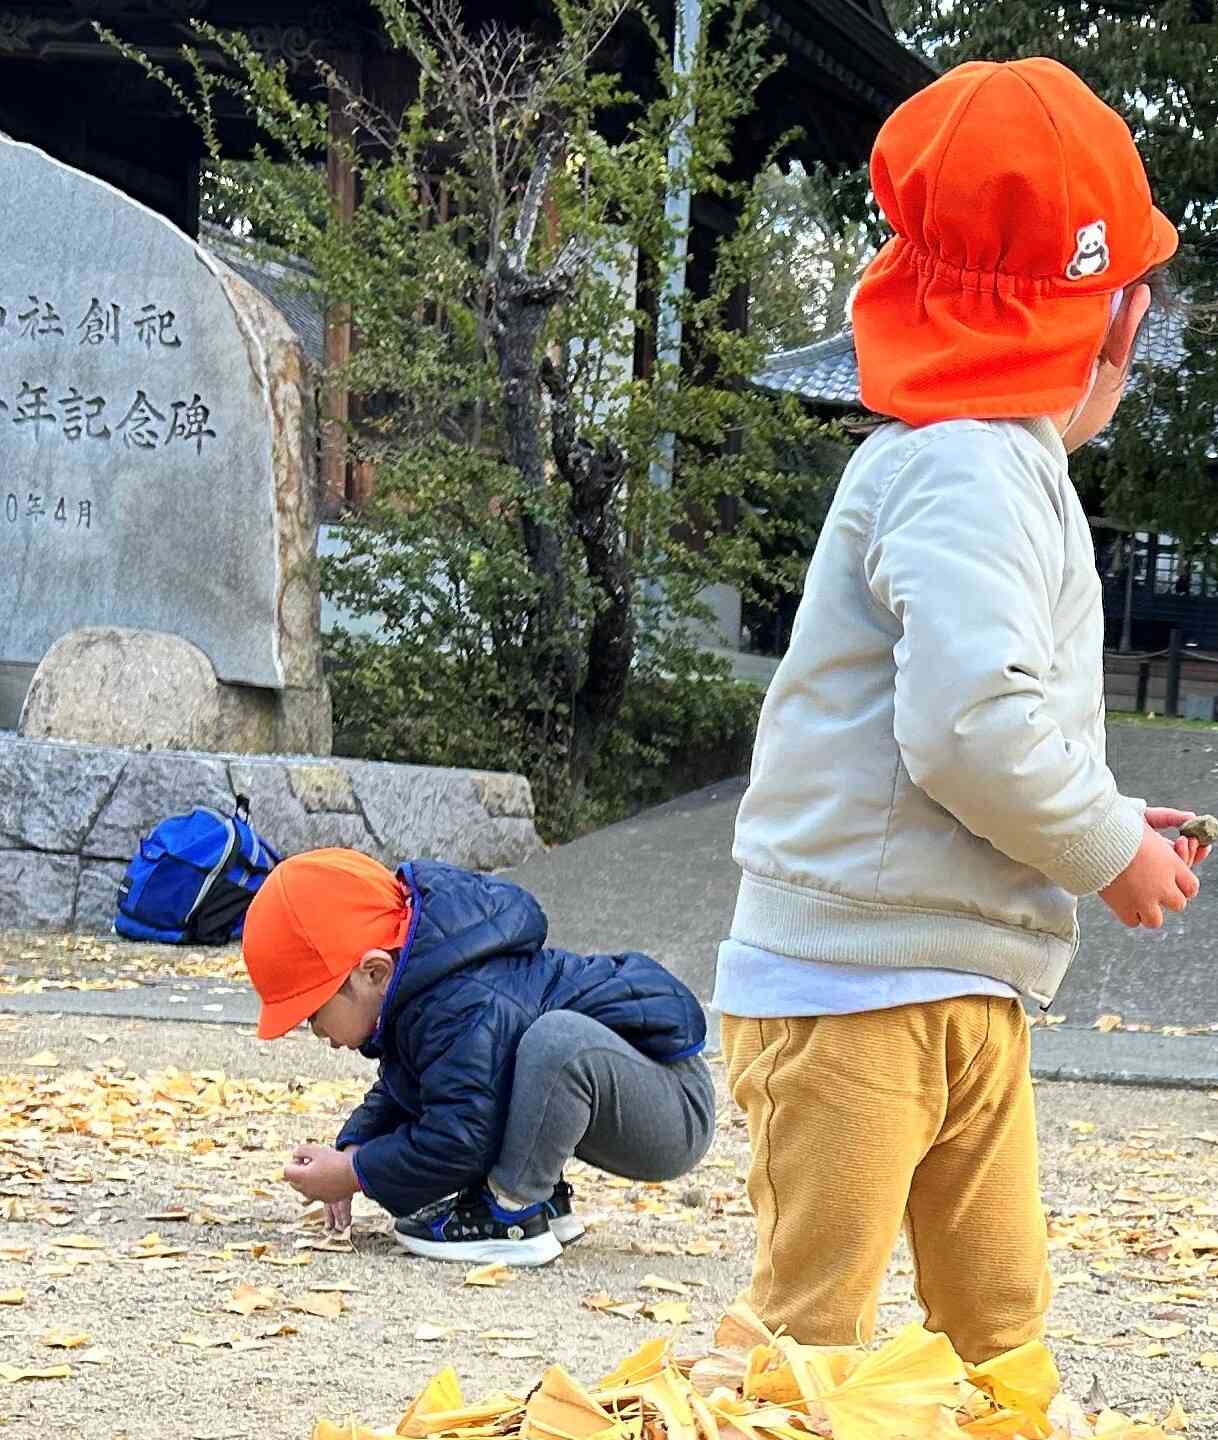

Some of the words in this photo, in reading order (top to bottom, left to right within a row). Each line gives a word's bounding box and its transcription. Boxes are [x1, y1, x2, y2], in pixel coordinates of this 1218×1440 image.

[0, 295, 183, 350] 社創祀
[0, 381, 217, 455] 年記念碑
